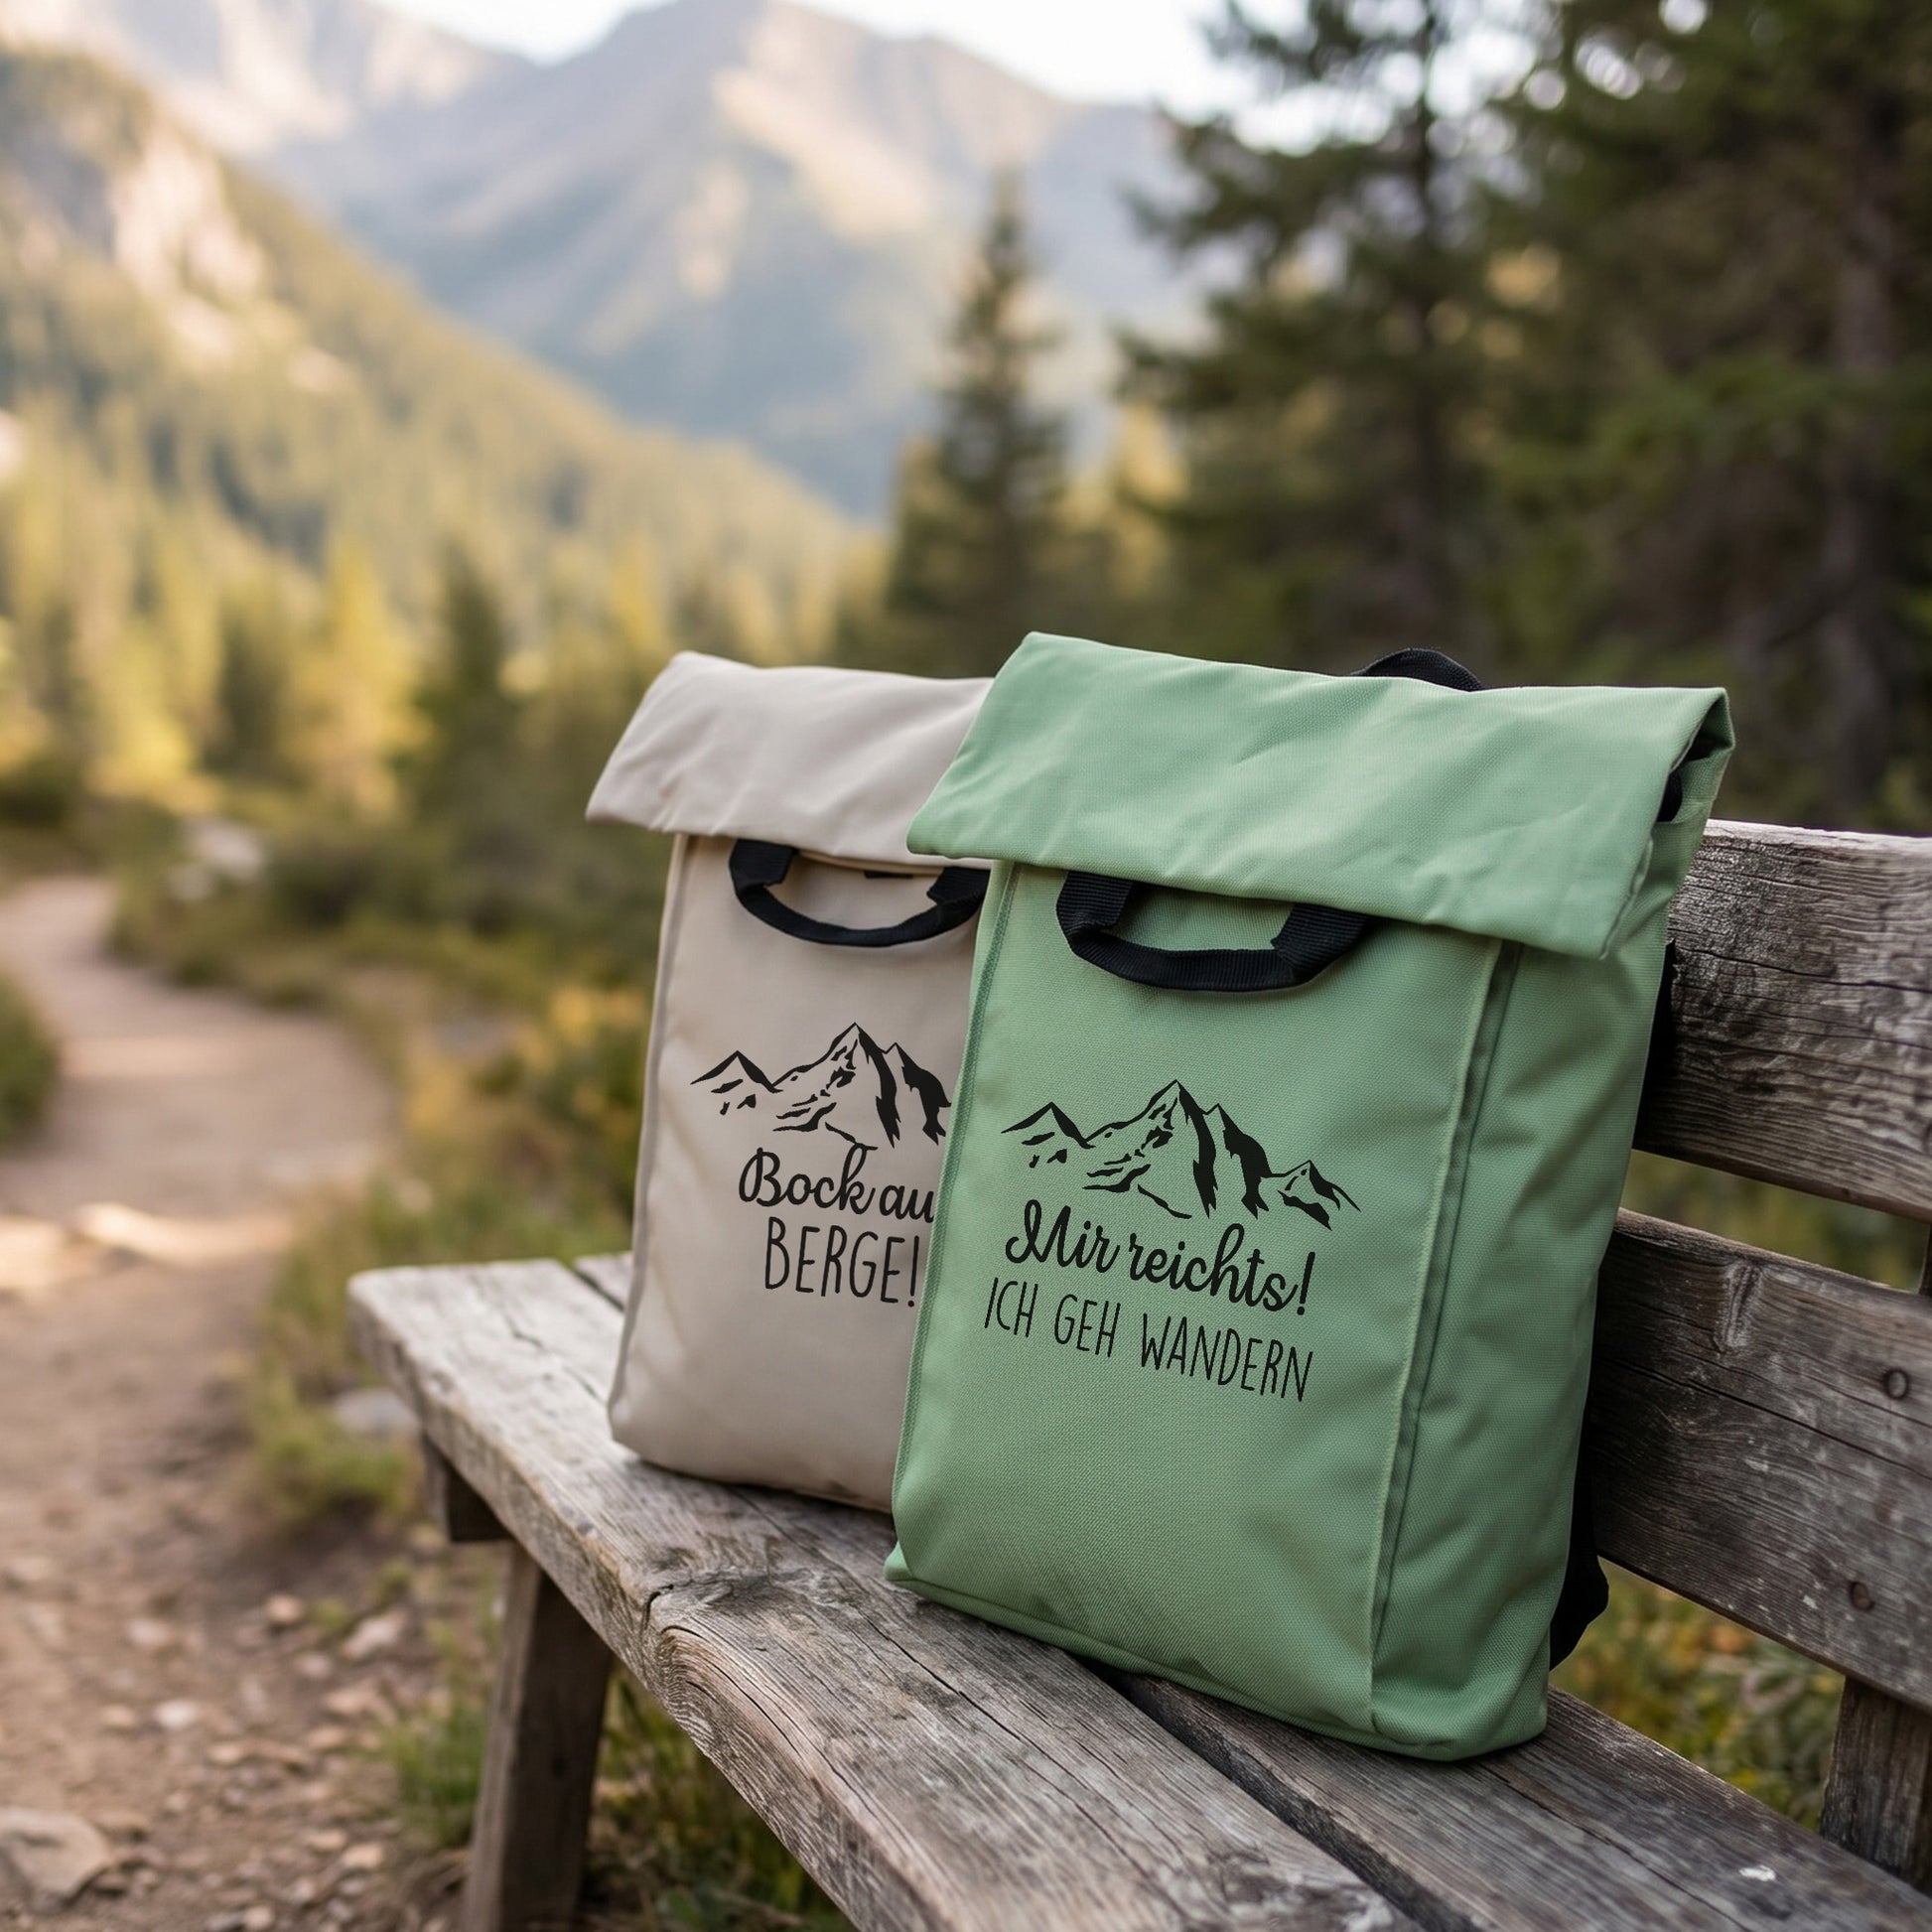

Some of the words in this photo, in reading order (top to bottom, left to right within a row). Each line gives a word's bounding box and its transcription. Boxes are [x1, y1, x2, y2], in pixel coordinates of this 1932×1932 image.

[739, 1143, 876, 1214] Bock
[879, 1184, 935, 1223] au
[764, 1216, 919, 1308] BERGE!
[1005, 1198, 1120, 1274] Mir
[1129, 1223, 1315, 1315] reichts!
[984, 1277, 1038, 1337] ICH
[1054, 1294, 1121, 1357] GEH
[1141, 1312, 1313, 1402] WANDERN
